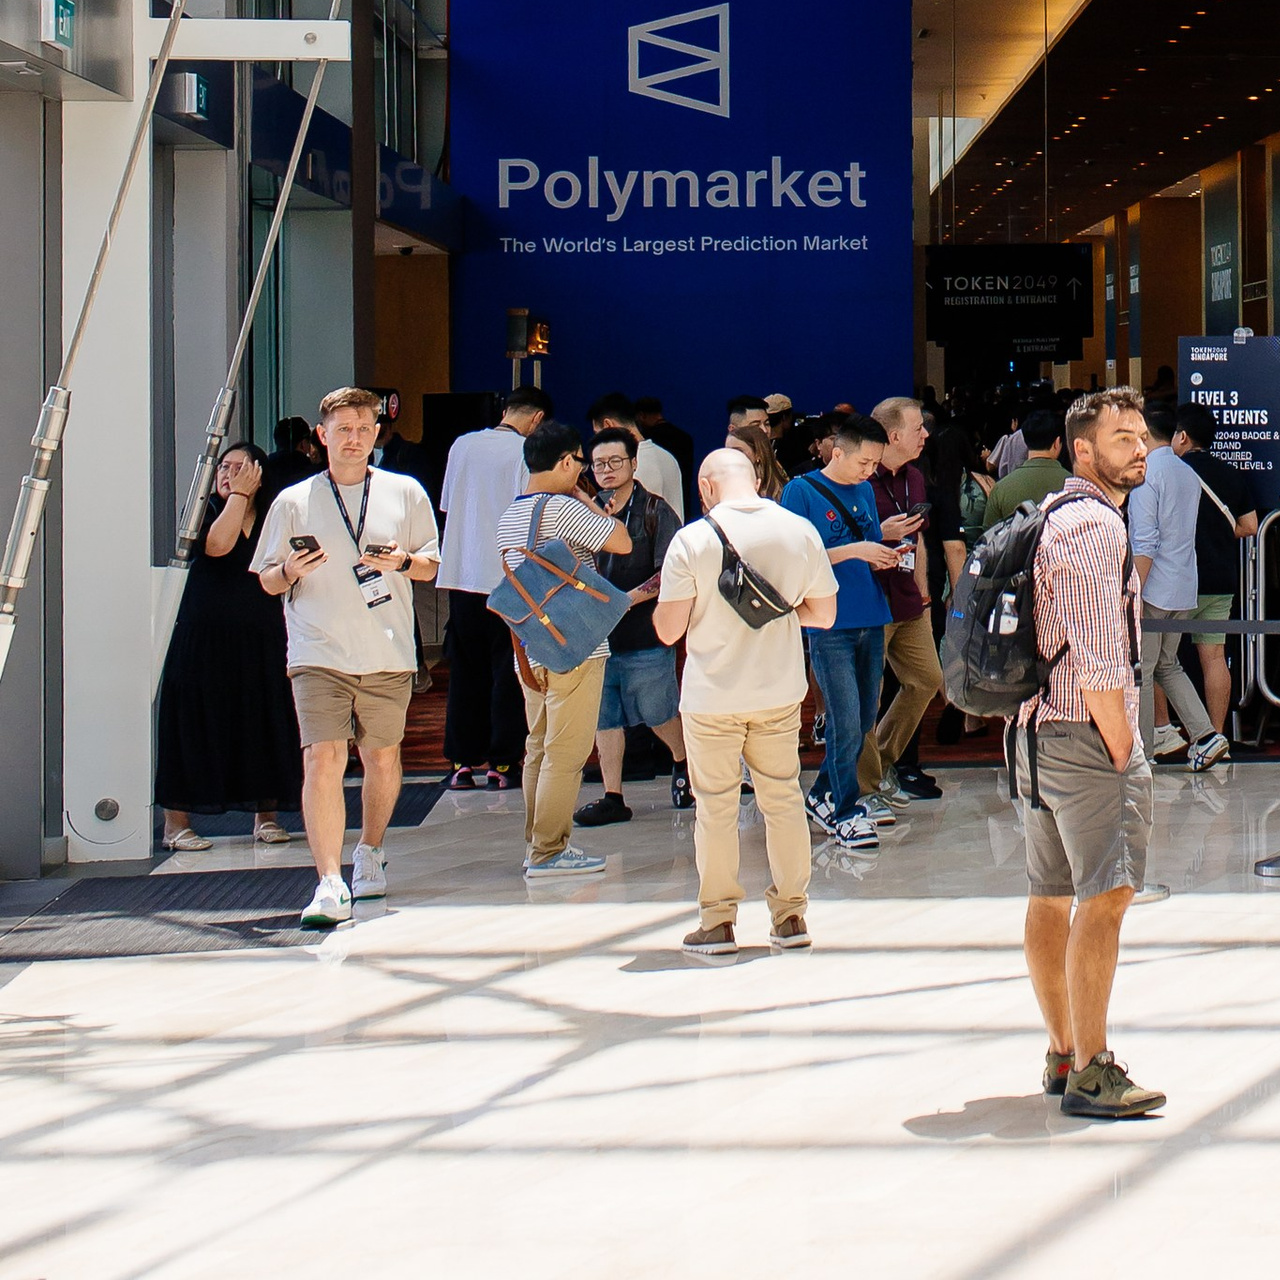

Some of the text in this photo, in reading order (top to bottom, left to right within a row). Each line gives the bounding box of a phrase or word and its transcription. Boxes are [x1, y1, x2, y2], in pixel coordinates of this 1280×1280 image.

[498, 156, 867, 222] Polymarket
[500, 237, 537, 253] The
[623, 236, 695, 255] Largest
[700, 235, 798, 251] Prediction
[803, 235, 868, 251] Market
[943, 275, 1058, 291] TOKEN2049
[944, 296, 1005, 306] REGISTRATION
[1015, 295, 1058, 304] ENTRANCE
[1190, 352, 1228, 361] SINGAPORE
[1190, 390, 1239, 406] LEVEL 3
[1223, 409, 1269, 425] EVENTS
[1241, 431, 1272, 440] BADGE
[1273, 431, 1280, 440] &
[1239, 461, 1266, 470] LEVEL
[1266, 461, 1273, 470] 3
